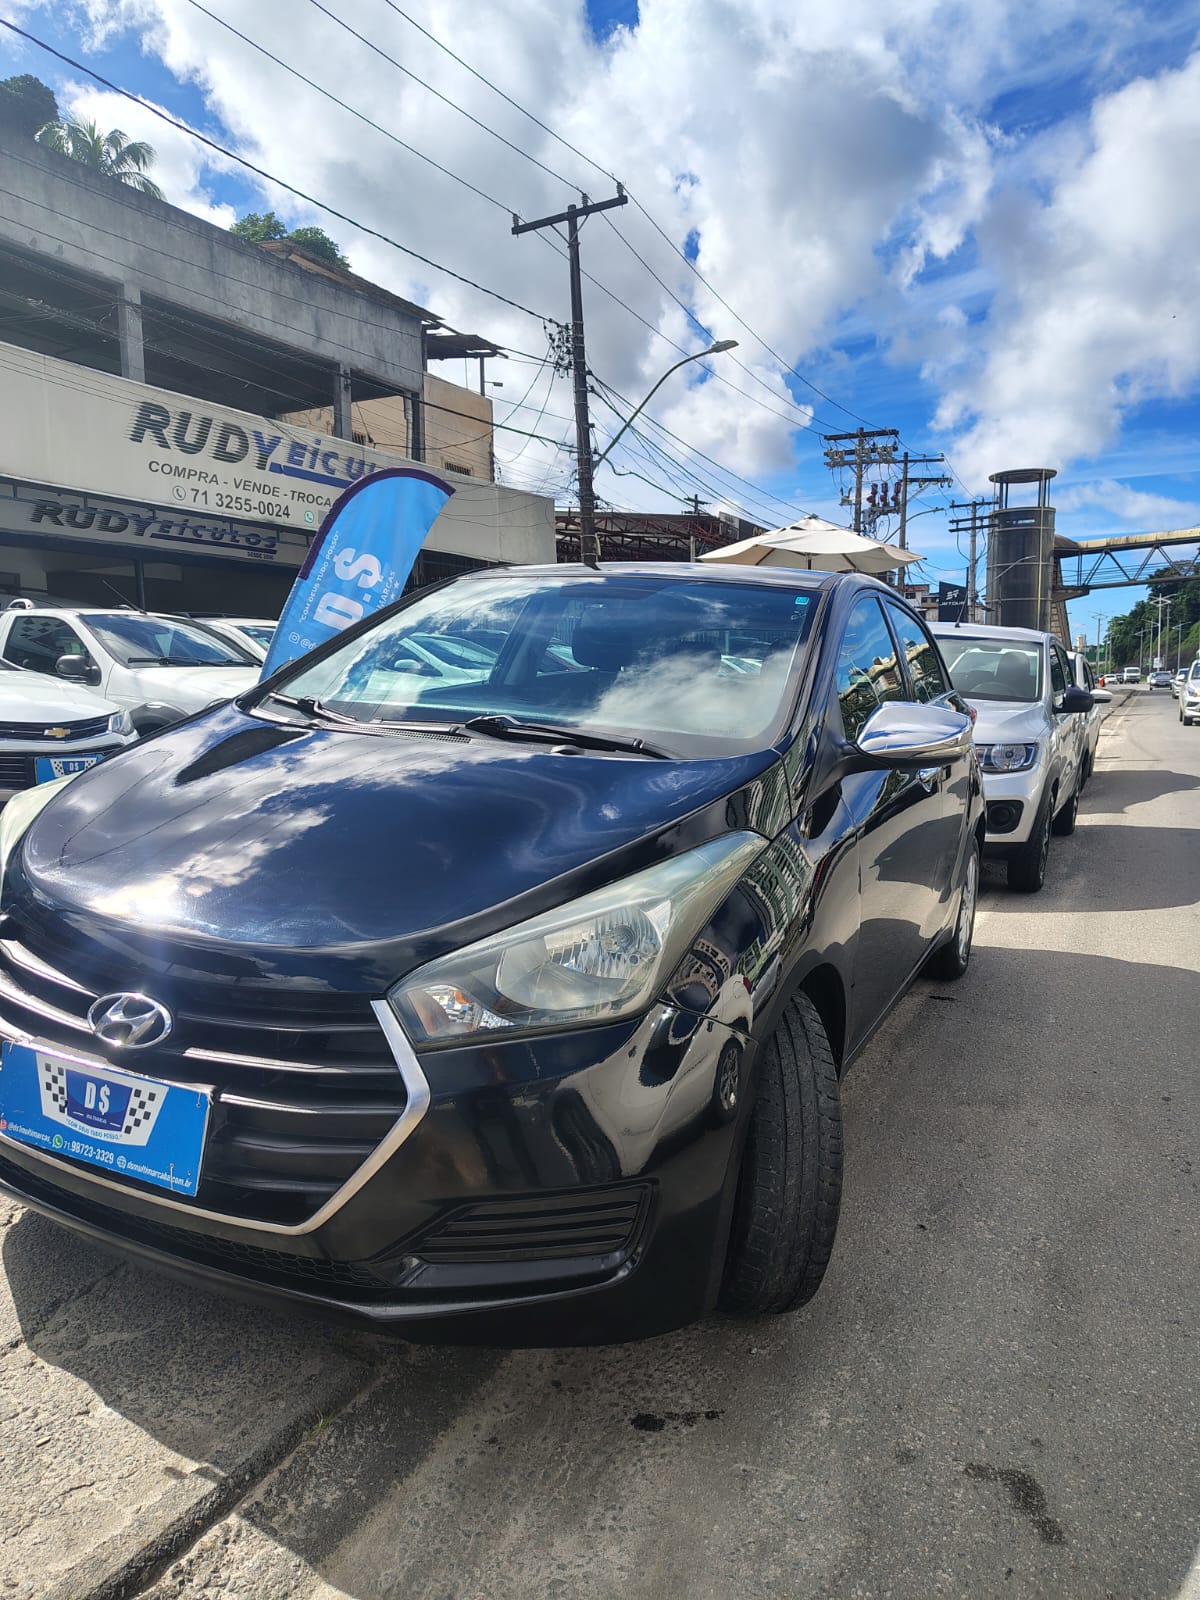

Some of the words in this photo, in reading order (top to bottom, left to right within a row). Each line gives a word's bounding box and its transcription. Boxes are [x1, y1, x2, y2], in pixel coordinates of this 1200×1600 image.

[148, 460, 219, 486] COMPRA
[233, 477, 281, 497] VENDE
[190, 487, 208, 505] 71
[215, 492, 291, 518] 3255-0024
[308, 582, 321, 603] DEUS
[316, 560, 329, 582] TUDO
